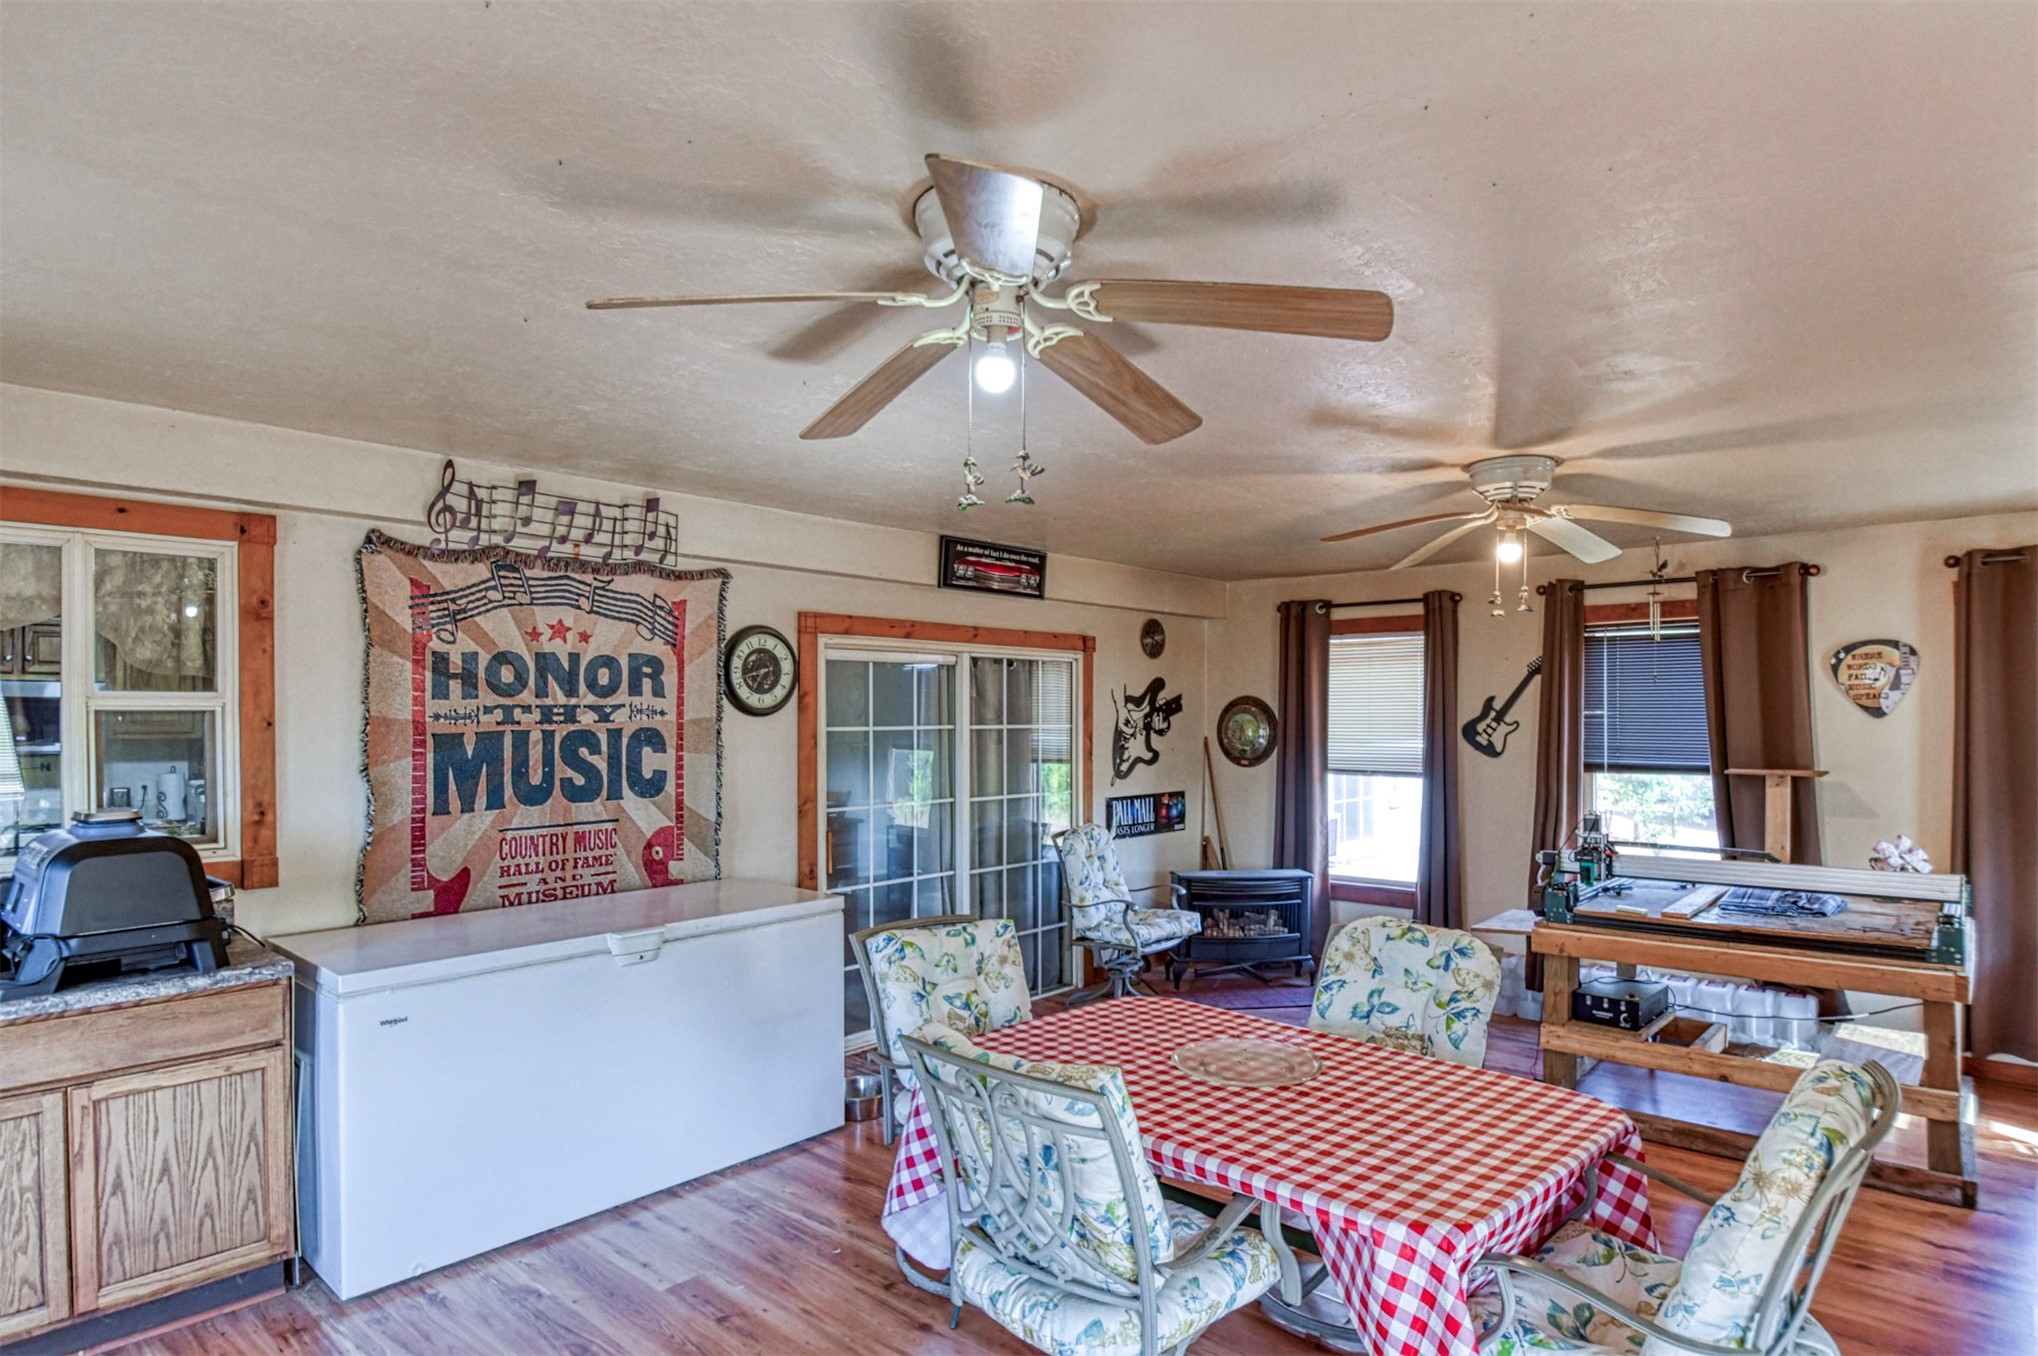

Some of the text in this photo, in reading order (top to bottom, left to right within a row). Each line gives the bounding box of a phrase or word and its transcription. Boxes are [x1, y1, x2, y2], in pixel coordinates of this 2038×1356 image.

[758, 638, 767, 647] 12
[431, 650, 667, 700] HONOR
[1846, 662, 1877, 670] WORDS
[483, 703, 626, 726] THY
[431, 727, 668, 816] MUSIC
[1112, 797, 1155, 826] PALL MALL
[1115, 823, 1155, 835] ASTS LONGER
[499, 828, 617, 861] COUNTRY MUSIC
[499, 854, 614, 878] HALL OF FAME
[536, 873, 584, 886] AND
[499, 879, 617, 908] MUSEUM
